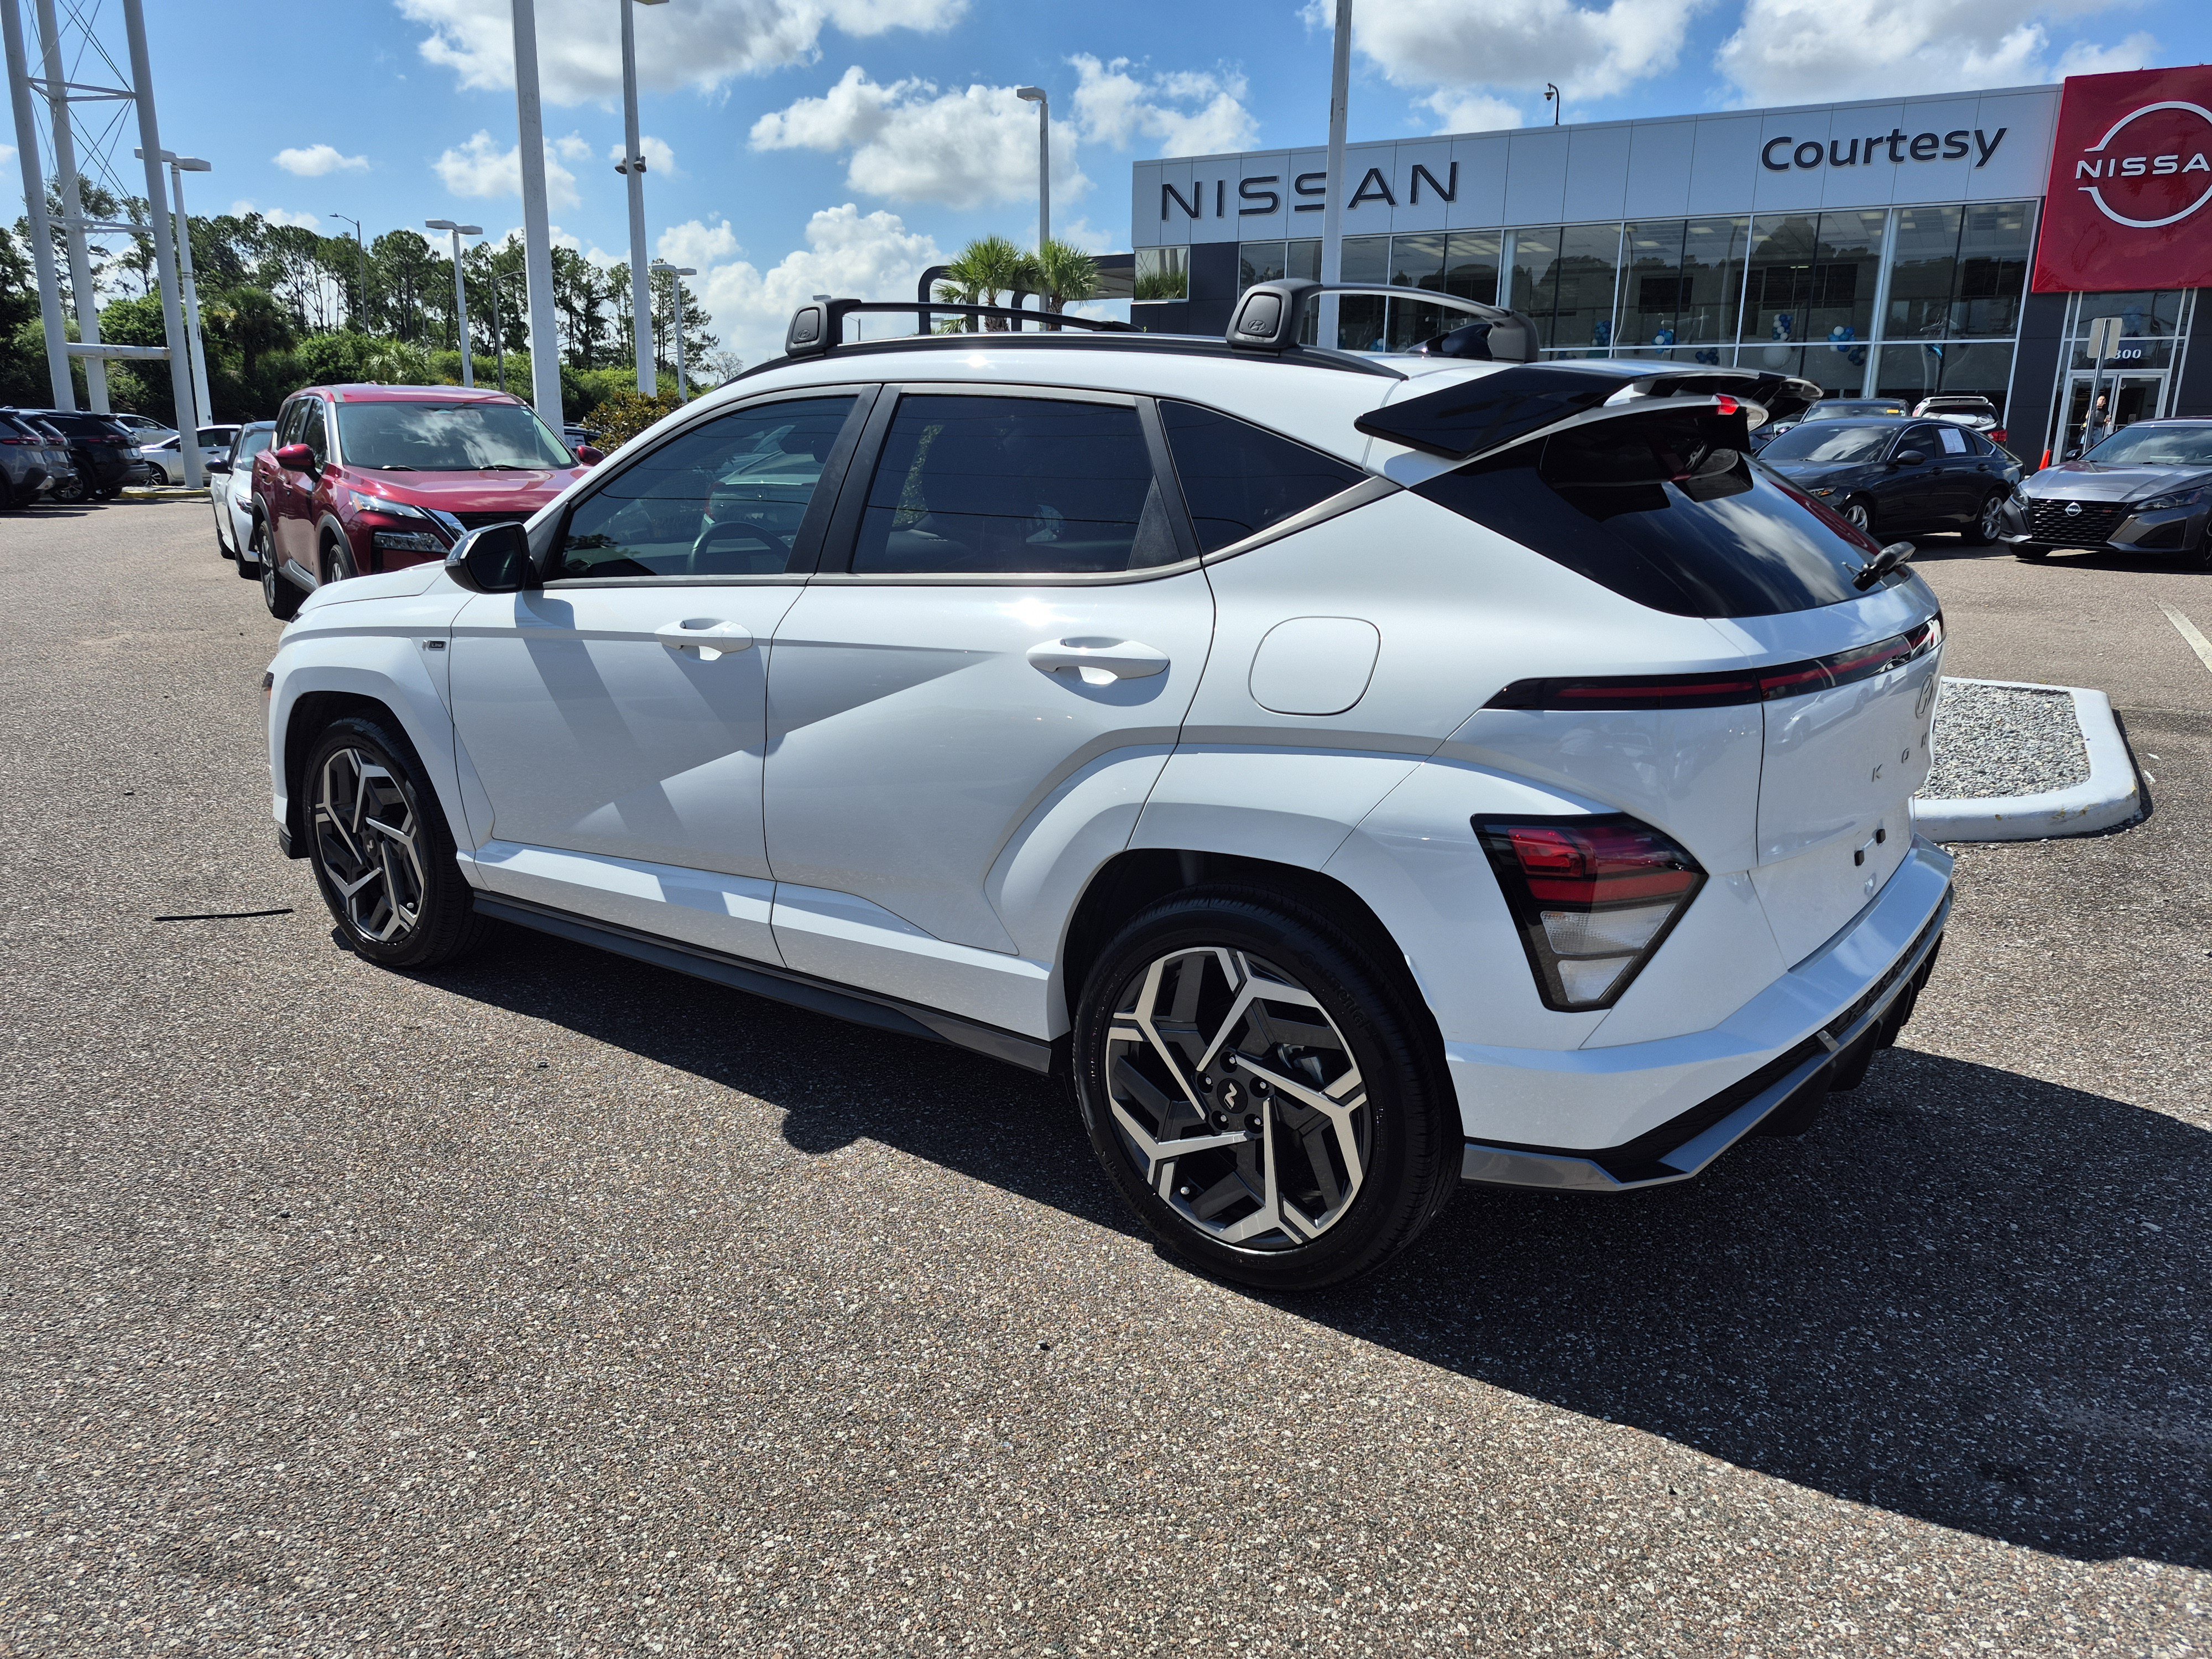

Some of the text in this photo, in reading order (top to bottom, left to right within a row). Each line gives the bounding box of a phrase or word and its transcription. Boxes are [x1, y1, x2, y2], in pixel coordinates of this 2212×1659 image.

[1761, 127, 2008, 171] Courtesy
[2075, 153, 2211, 180] NISSA
[1161, 161, 1458, 221] NISSAN
